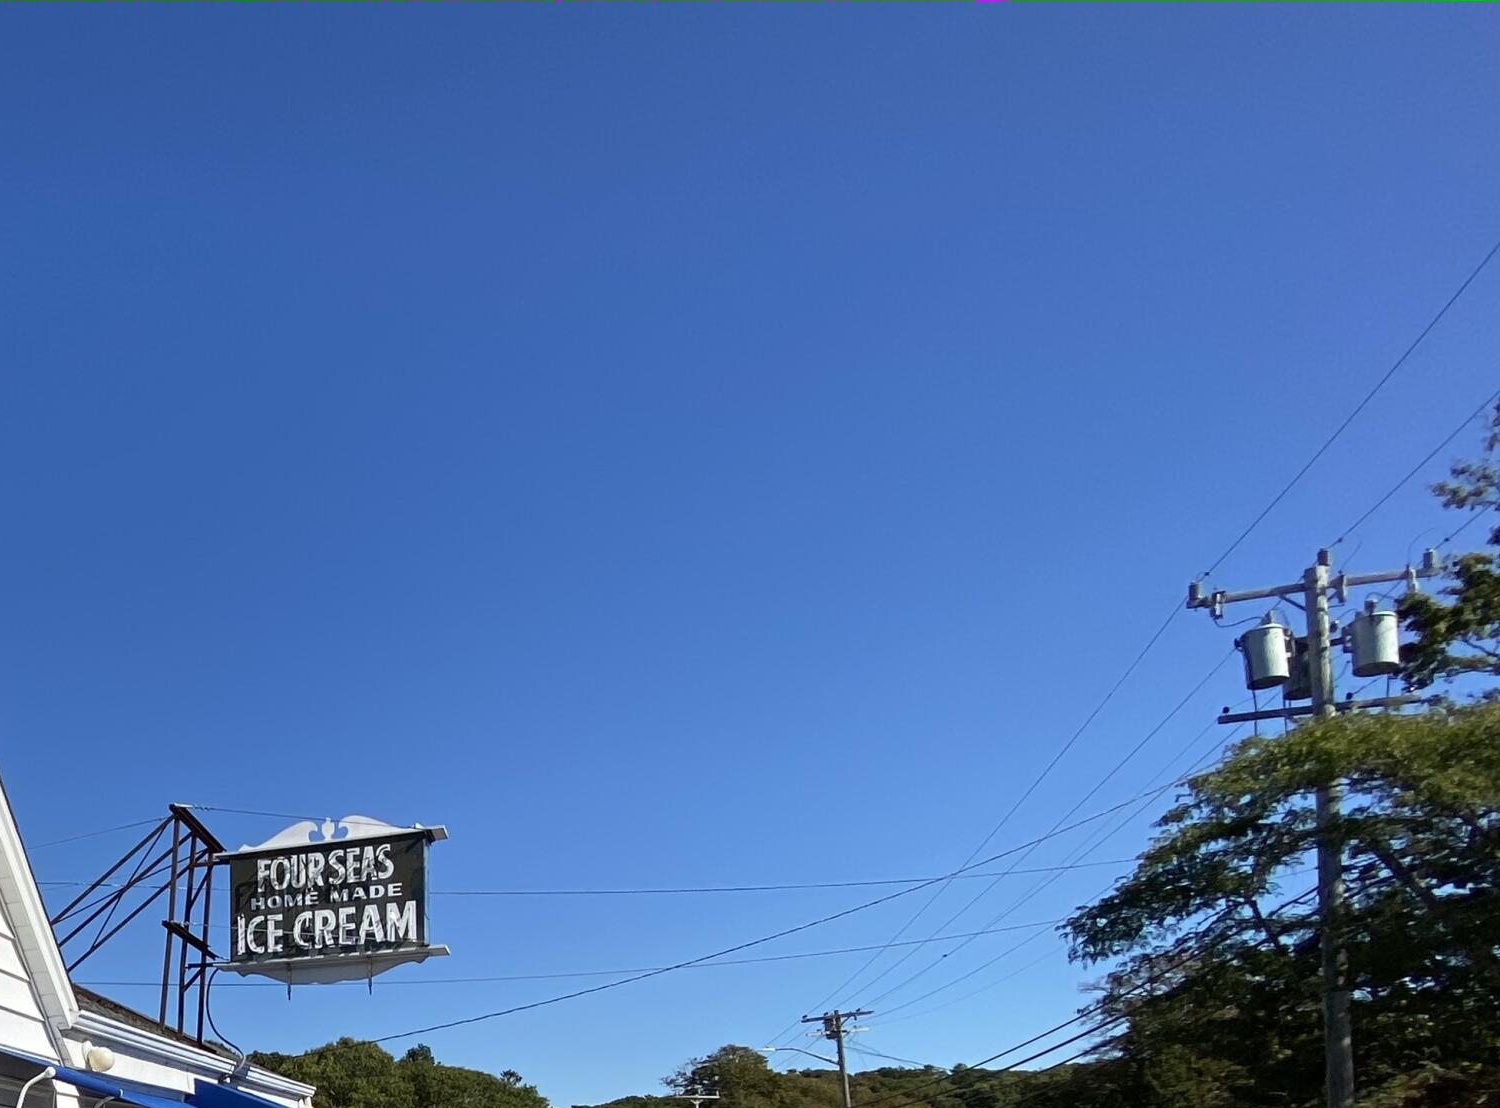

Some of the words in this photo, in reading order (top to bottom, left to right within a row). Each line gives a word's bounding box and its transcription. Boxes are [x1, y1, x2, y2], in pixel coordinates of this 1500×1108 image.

[257, 853, 325, 892] FOUR
[328, 844, 395, 885] SEAS
[251, 893, 319, 910] HOME
[330, 883, 402, 902] MADE
[237, 914, 284, 956] ICE
[293, 900, 418, 948] CREAM
